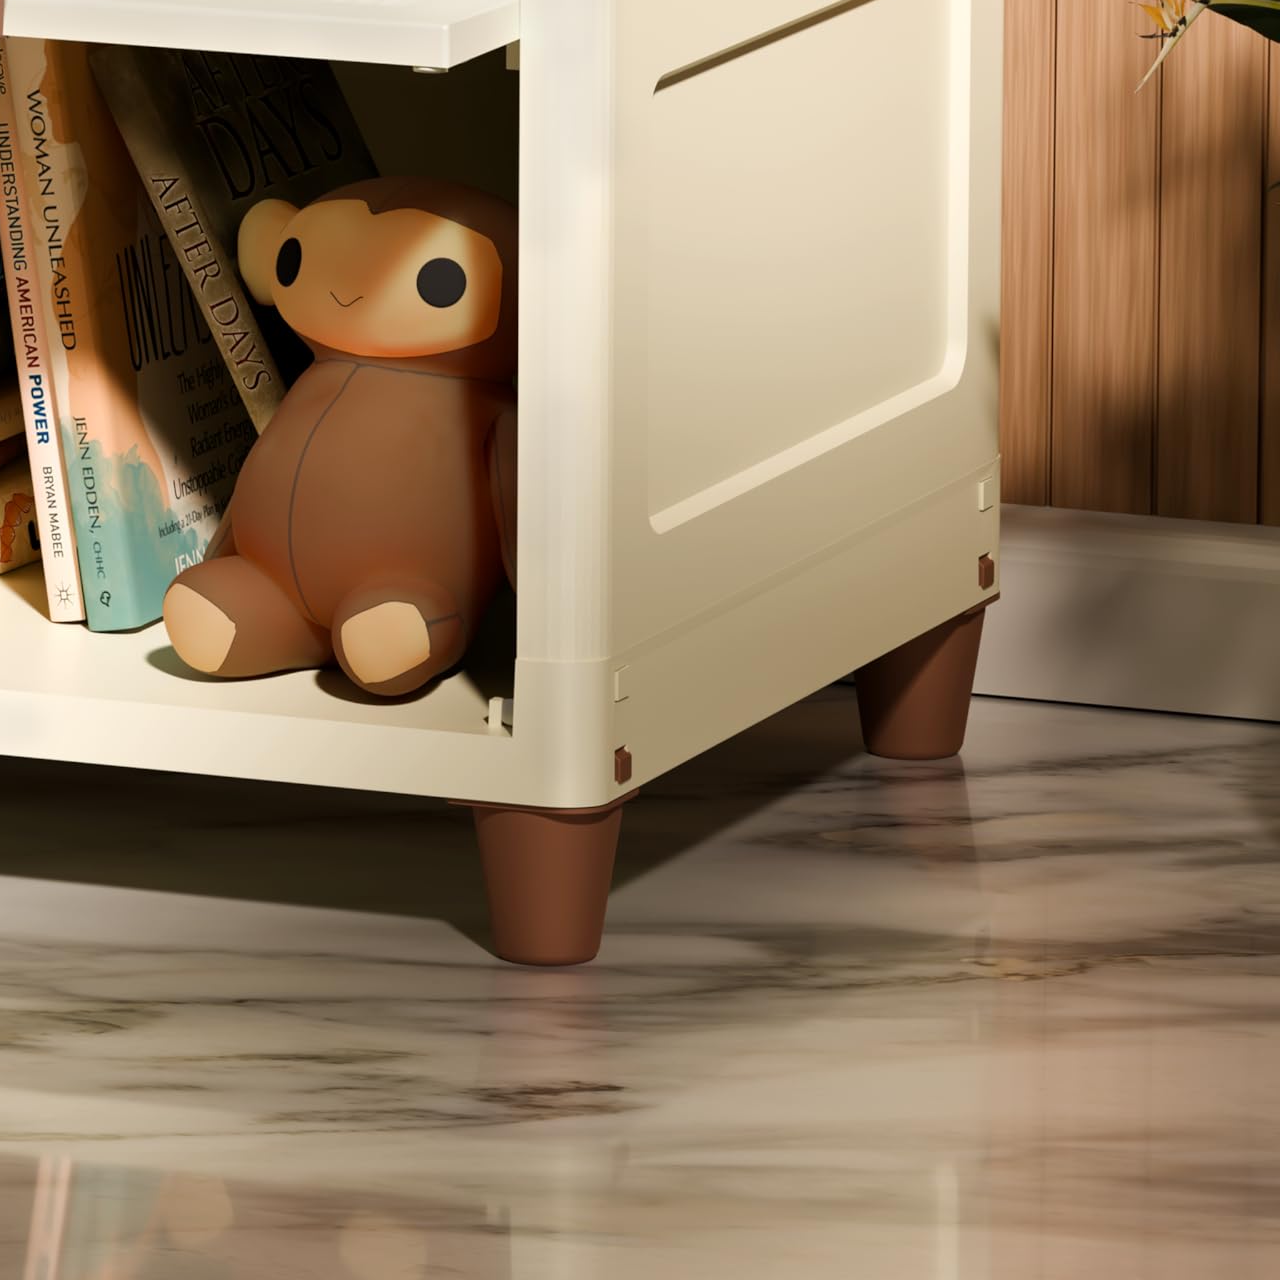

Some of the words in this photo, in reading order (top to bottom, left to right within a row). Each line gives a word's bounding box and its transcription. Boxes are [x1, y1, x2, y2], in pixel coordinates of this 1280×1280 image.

[194, 78, 343, 200] DAYS
[26, 89, 55, 196] WOMAN
[42, 206, 77, 351] UNLEASHED
[151, 174, 221, 293] AFTER
[209, 291, 272, 392] DAYS
[15, 276, 40, 368] AMERICAN
[28, 374, 50, 445] POWER
[177, 370, 196, 394] The
[42, 466, 58, 510] BRYAN
[72, 416, 91, 460] JENN
[82, 466, 102, 534] EDDEN,
[172, 462, 226, 500] Unstoppable
[48, 512, 64, 558] MABEE
[158, 518, 181, 538] Including
